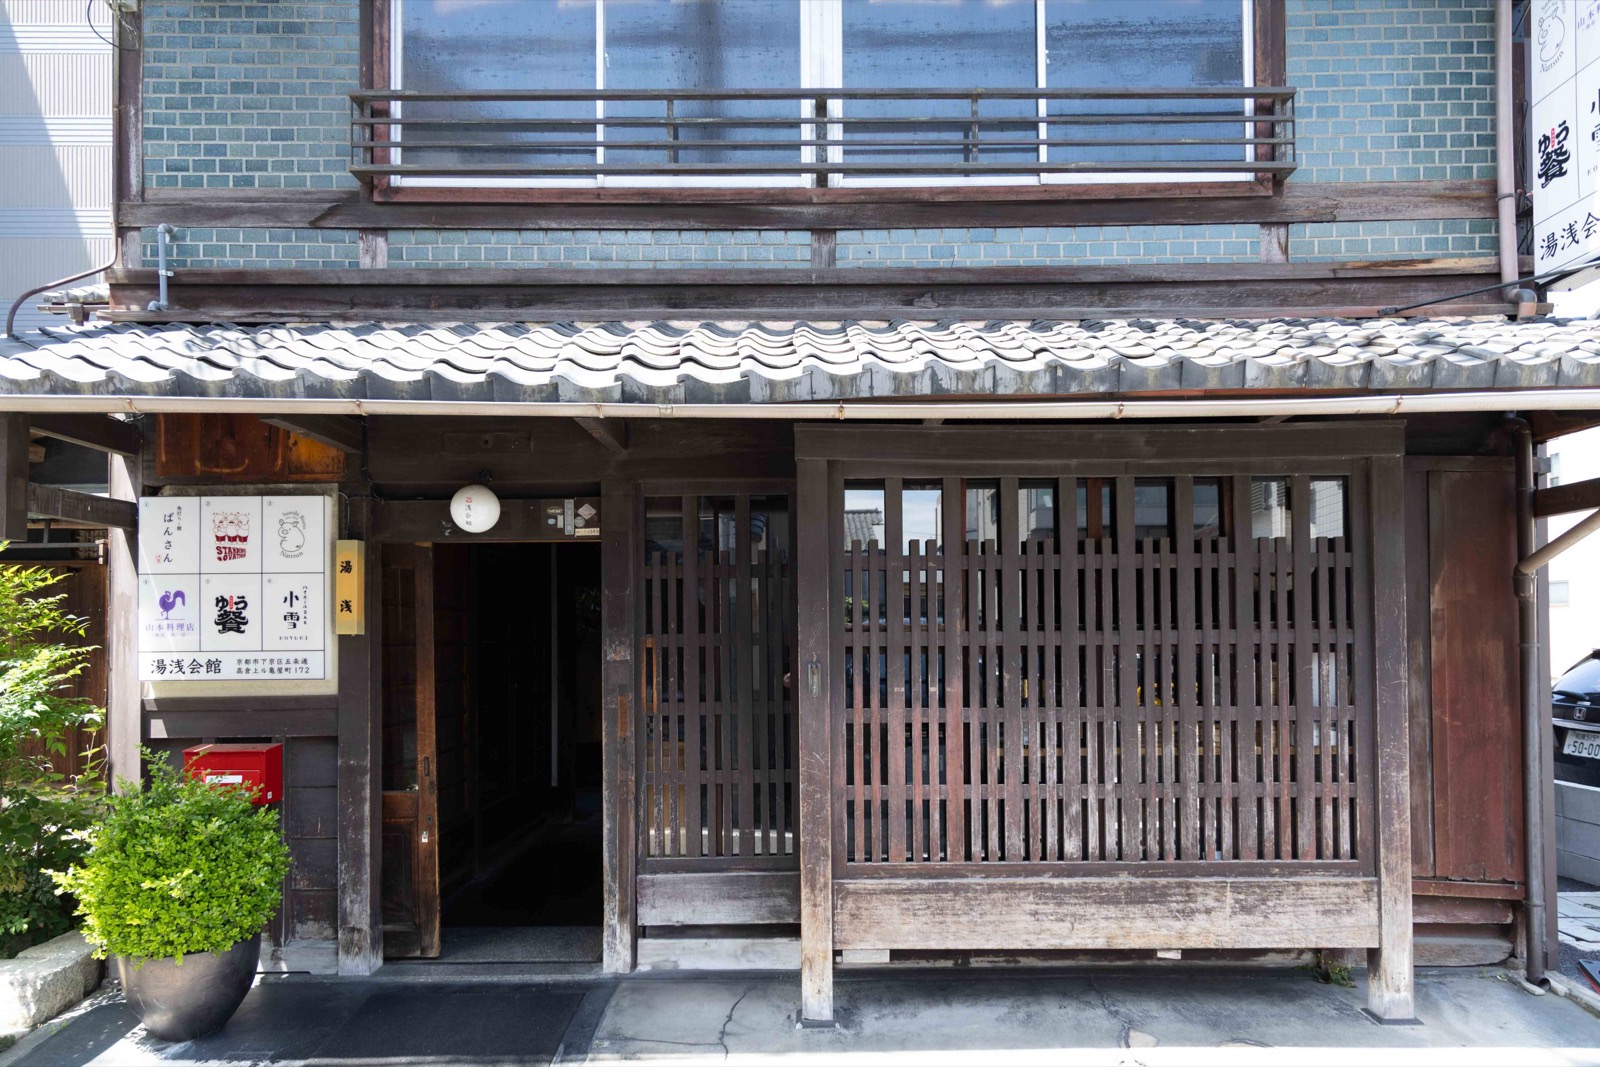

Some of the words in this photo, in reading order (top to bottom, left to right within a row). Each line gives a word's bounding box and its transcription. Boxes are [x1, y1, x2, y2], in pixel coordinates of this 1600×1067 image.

[1540, 212, 1600, 261] 湯浅会
[163, 512, 174, 563] ばんさん
[340, 560, 353, 614] 湯浅
[145, 622, 195, 632] 山本料理店
[283, 590, 300, 630] 小雪
[150, 658, 223, 675] 湯浅会館
[236, 658, 309, 666] 京都市下京区五条通
